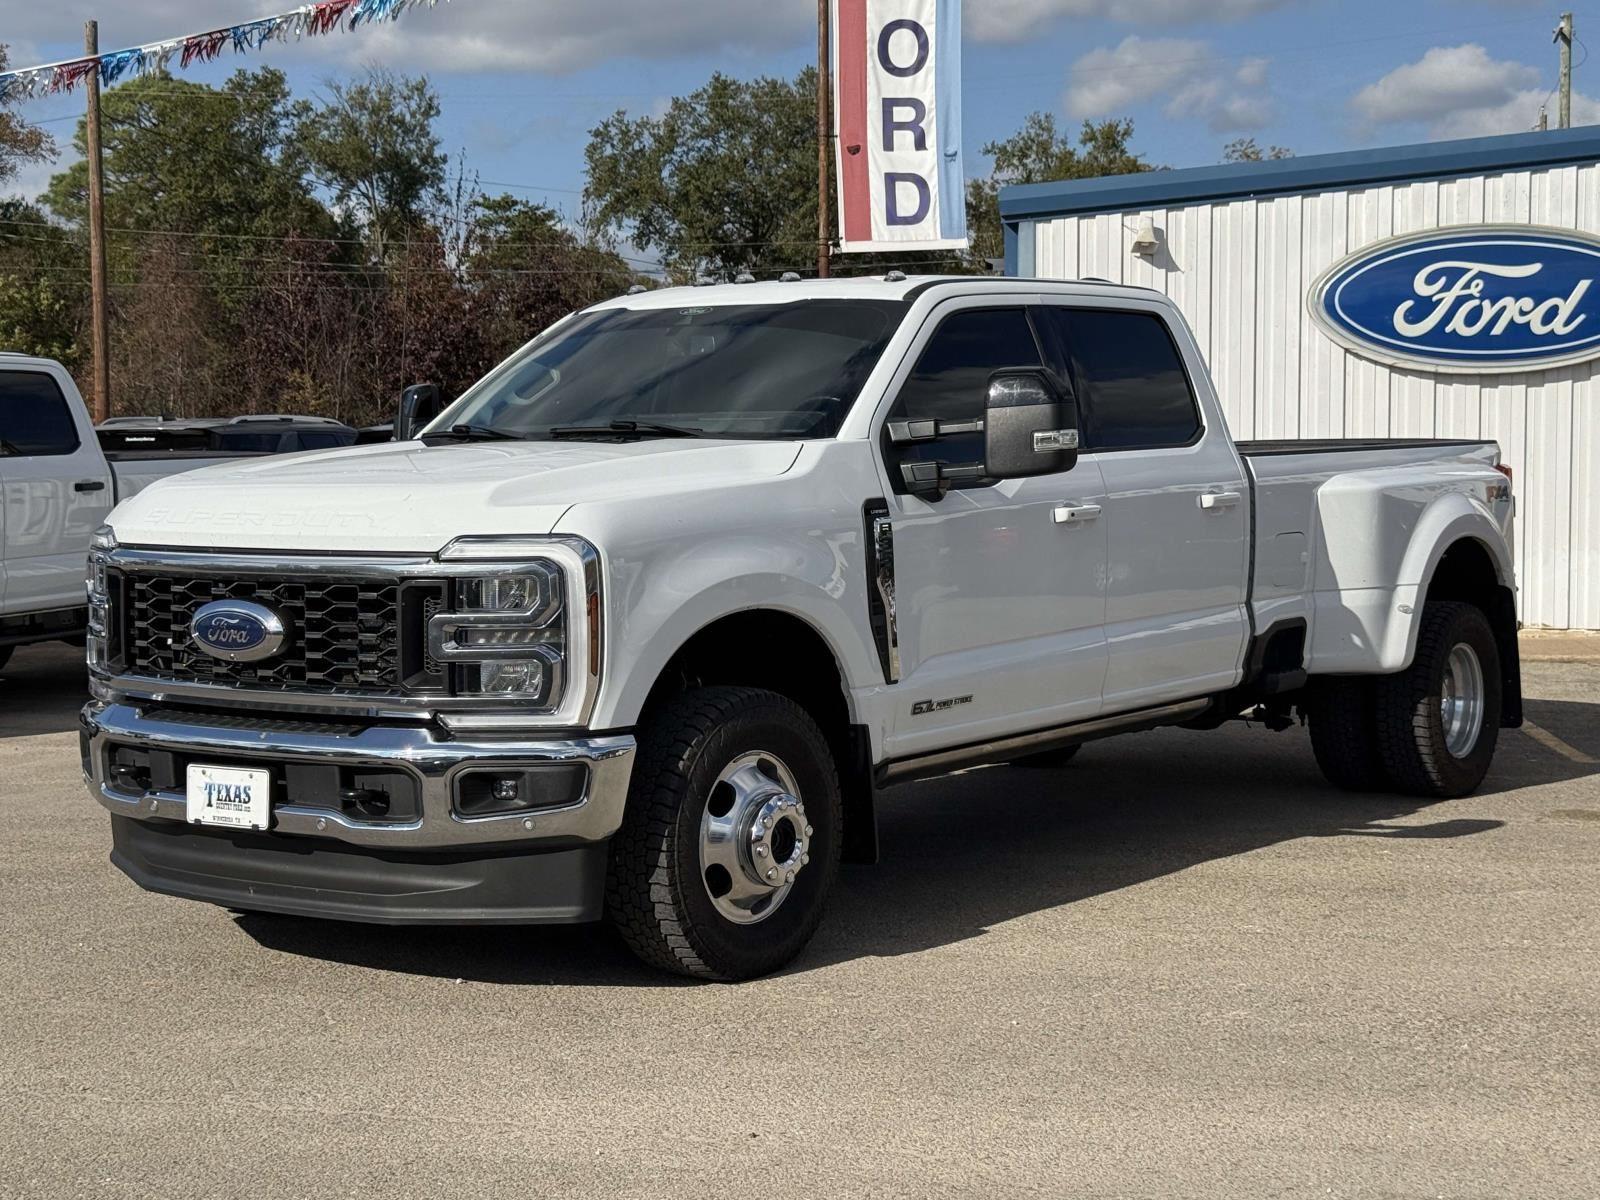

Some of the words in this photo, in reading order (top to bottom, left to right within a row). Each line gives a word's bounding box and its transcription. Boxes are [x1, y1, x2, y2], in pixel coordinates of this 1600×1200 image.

[1393, 261, 1593, 338] Ford
[144, 508, 266, 527] SUPER
[207, 616, 250, 643] Ford
[911, 699, 935, 715] 6.7L
[204, 783, 251, 807] TEXAS
